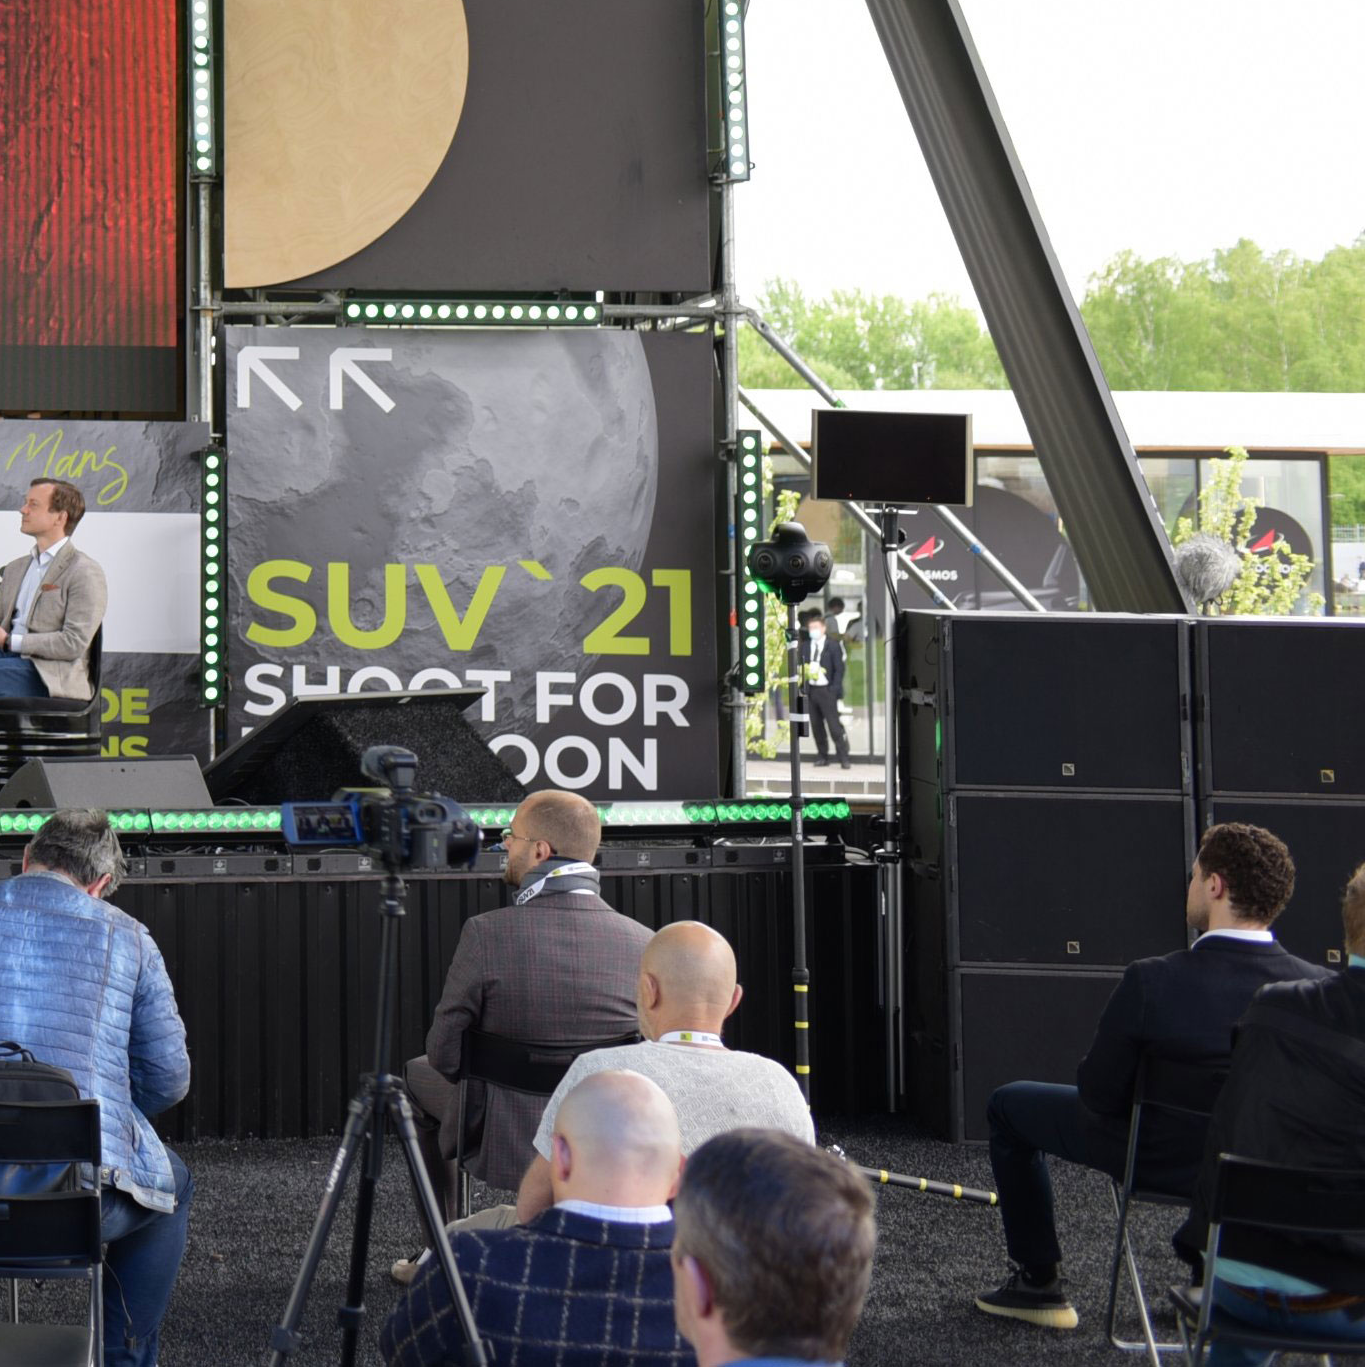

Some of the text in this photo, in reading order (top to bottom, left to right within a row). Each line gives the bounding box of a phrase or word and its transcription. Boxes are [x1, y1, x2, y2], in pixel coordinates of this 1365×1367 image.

[6, 429, 128, 505] Mars
[535, 671, 690, 727] FOR
[489, 734, 658, 790] OON
